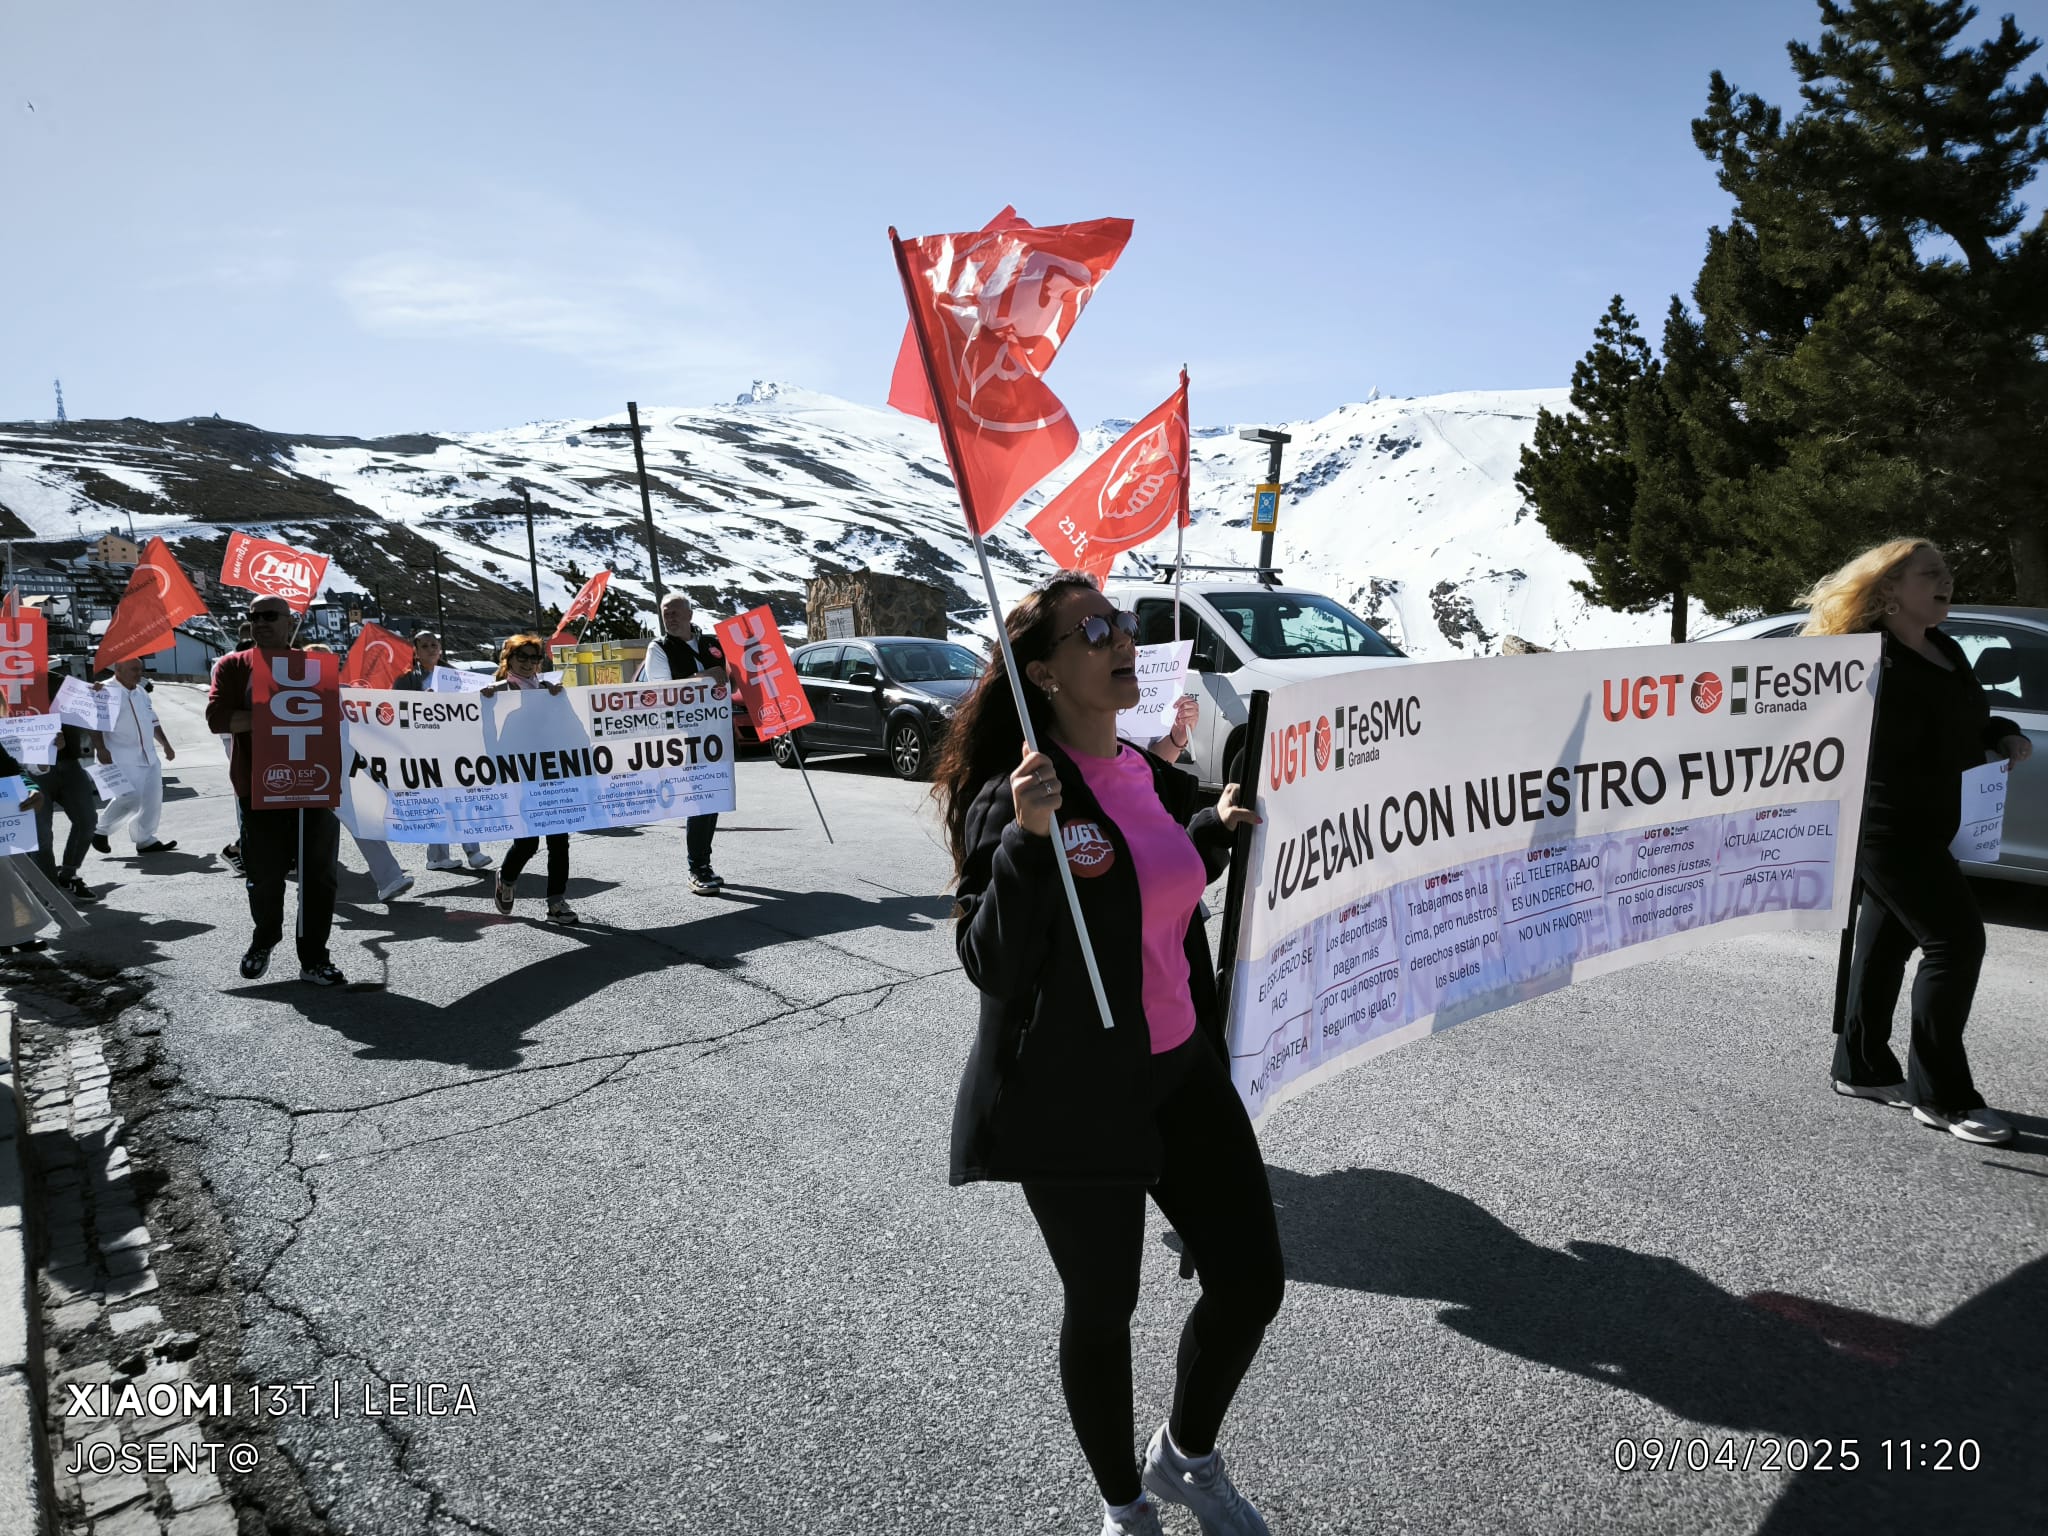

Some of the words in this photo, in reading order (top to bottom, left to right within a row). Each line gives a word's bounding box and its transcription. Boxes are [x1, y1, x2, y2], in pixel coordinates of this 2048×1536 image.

[0, 623, 34, 704] UGT
[728, 614, 784, 699] UGT
[1137, 660, 1180, 675] ALTITUD
[591, 690, 638, 712] UGT
[663, 684, 708, 706] UGT
[1139, 686, 1159, 698] OS
[1603, 673, 1684, 722] UGT
[1755, 659, 1865, 700] FeSMC
[269, 656, 323, 760] UGT
[412, 702, 480, 722] FeSMC
[1136, 702, 1165, 715] PLUS
[1754, 699, 1808, 714] Granada
[414, 722, 440, 730] Granada
[605, 712, 659, 731] FeSMC
[676, 706, 729, 724] FeSMC
[1270, 720, 1311, 791] UGT
[1348, 695, 1421, 748] FeSMC
[400, 757, 443, 789] UN
[454, 744, 614, 787] CONVENIO
[627, 733, 724, 772] JUSTO
[1348, 746, 1380, 767] Granada
[266, 769, 292, 781] UGT
[609, 779, 644, 789] Queremos
[664, 771, 715, 785] ACTUALIZACIÓN
[715, 771, 729, 779] DEL
[529, 789, 541, 797] Los
[541, 786, 580, 797] deportistas
[597, 788, 636, 800] condiciones
[1980, 781, 2004, 794] Los
[463, 793, 500, 804] ESFUERZO
[474, 804, 493, 812] PAGA
[559, 796, 574, 804] más
[558, 805, 587, 815] nosotros
[611, 808, 651, 819] motivadores
[1755, 809, 1772, 821] UGT
[463, 827, 473, 835] NO
[484, 824, 514, 834] REGATEA
[565, 815, 586, 826] igual?
[1268, 802, 1374, 911] JUEGAN
[1379, 781, 1460, 854] CON
[1465, 756, 1667, 837] NUESTRO
[1679, 736, 1845, 801] FUTURO
[1972, 820, 2000, 838] ¿por
[1063, 823, 1104, 851] UGT
[1644, 828, 1662, 840] UGT
[1724, 824, 1805, 849] ACTUALIZACIÓN
[1807, 824, 1833, 837] DEL
[1527, 849, 1543, 863] UGT
[1637, 840, 1695, 860] Queremos
[1760, 848, 1781, 862] IPC
[1506, 871, 1527, 892] ¡¡¡EL
[1527, 855, 1600, 881] TELETRABAJO
[1614, 863, 1676, 886] condiciones
[1677, 857, 1712, 875] justas,
[1742, 870, 1777, 889] ¡BASTA
[1779, 868, 1796, 880] YA!
[1424, 875, 1440, 890] UGT
[1618, 896, 1632, 907] no
[1634, 888, 1654, 904] solo
[1656, 878, 1705, 898] discursos
[1408, 890, 1464, 918] Trabajamos
[1464, 885, 1477, 900] en
[1478, 883, 1489, 896] la
[1512, 896, 1524, 912] ES
[1525, 893, 1541, 908] UN
[1541, 879, 1596, 904] DERECHO,
[1338, 906, 1351, 924] UGT
[1631, 902, 1694, 926] motivadores
[1326, 935, 1339, 953] Los
[1340, 915, 1388, 945] deportistas
[1404, 927, 1433, 947] cima,
[1433, 919, 1455, 938] pero
[1455, 905, 1498, 928] nuestros
[1518, 926, 1534, 942] NO
[1535, 920, 1551, 938] UN
[1552, 909, 1593, 933] FAVOR!!!
[1301, 946, 1313, 966] SE
[1410, 944, 1454, 972] derechos
[1454, 935, 1481, 954] están
[1482, 930, 1500, 948] por
[1333, 955, 1360, 979] pagan
[1361, 946, 1380, 964] más
[1435, 975, 1448, 989] los
[1449, 961, 1481, 983] suelos
[1320, 994, 1341, 1016] ¿por
[1340, 984, 1357, 1003] qué
[1358, 966, 1400, 993] nosotros
[1322, 1006, 1366, 1038] seguimos
[1368, 991, 1398, 1019] igual?
